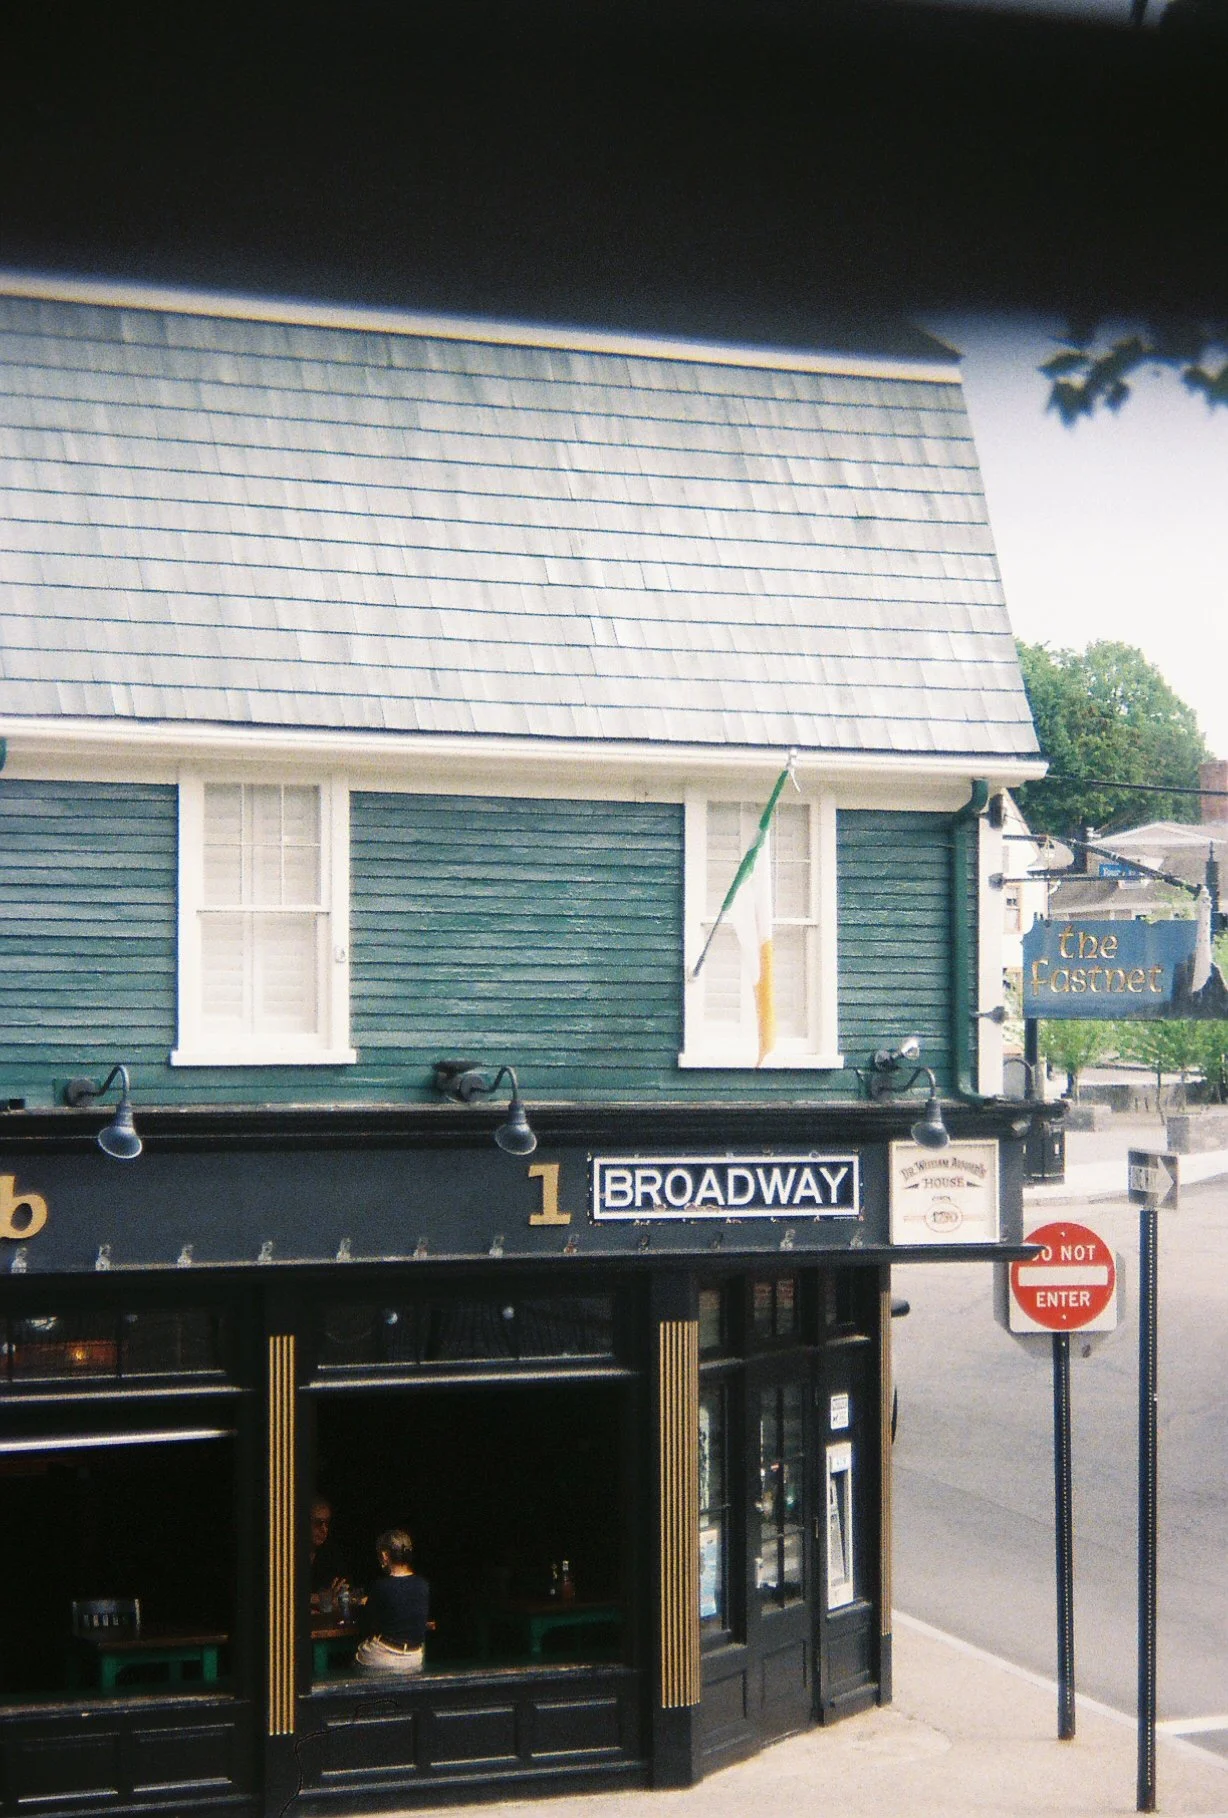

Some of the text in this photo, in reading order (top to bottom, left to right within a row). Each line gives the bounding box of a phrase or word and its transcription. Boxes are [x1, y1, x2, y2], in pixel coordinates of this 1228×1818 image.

[1058, 924, 1119, 959] the
[1031, 957, 1164, 997] Fastnet
[528, 1163, 571, 1226] 1
[604, 1166, 849, 1208] BROADWAY
[923, 1177, 965, 1189] HOUSE
[1060, 1245, 1096, 1261] NOT
[1036, 1291, 1091, 1308] ENTER
